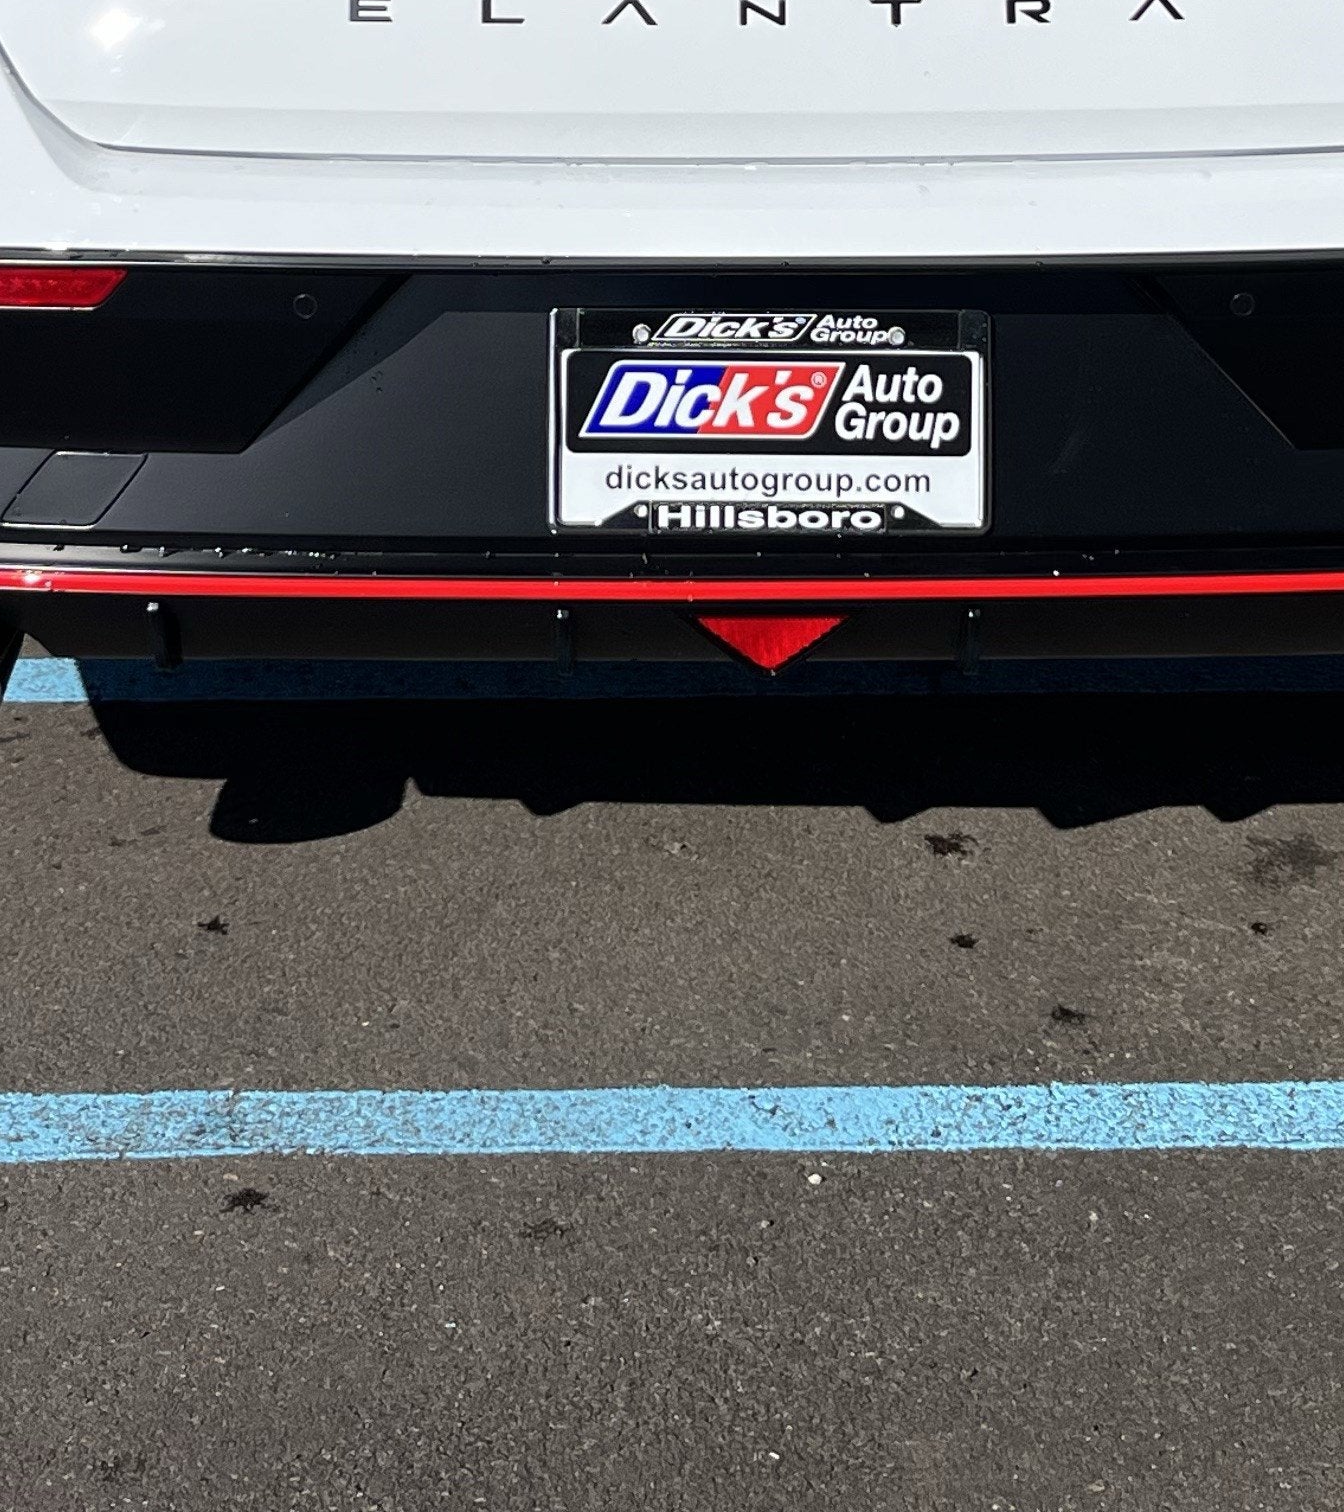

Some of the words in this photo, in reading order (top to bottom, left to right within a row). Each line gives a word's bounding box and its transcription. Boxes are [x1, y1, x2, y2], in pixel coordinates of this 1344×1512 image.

[810, 327, 891, 345] Group
[816, 314, 878, 329] Auto
[841, 364, 943, 403] Auto
[834, 401, 960, 449] Group
[605, 465, 931, 497] dicksautogroup.com
[657, 504, 883, 530] Hillsboro
